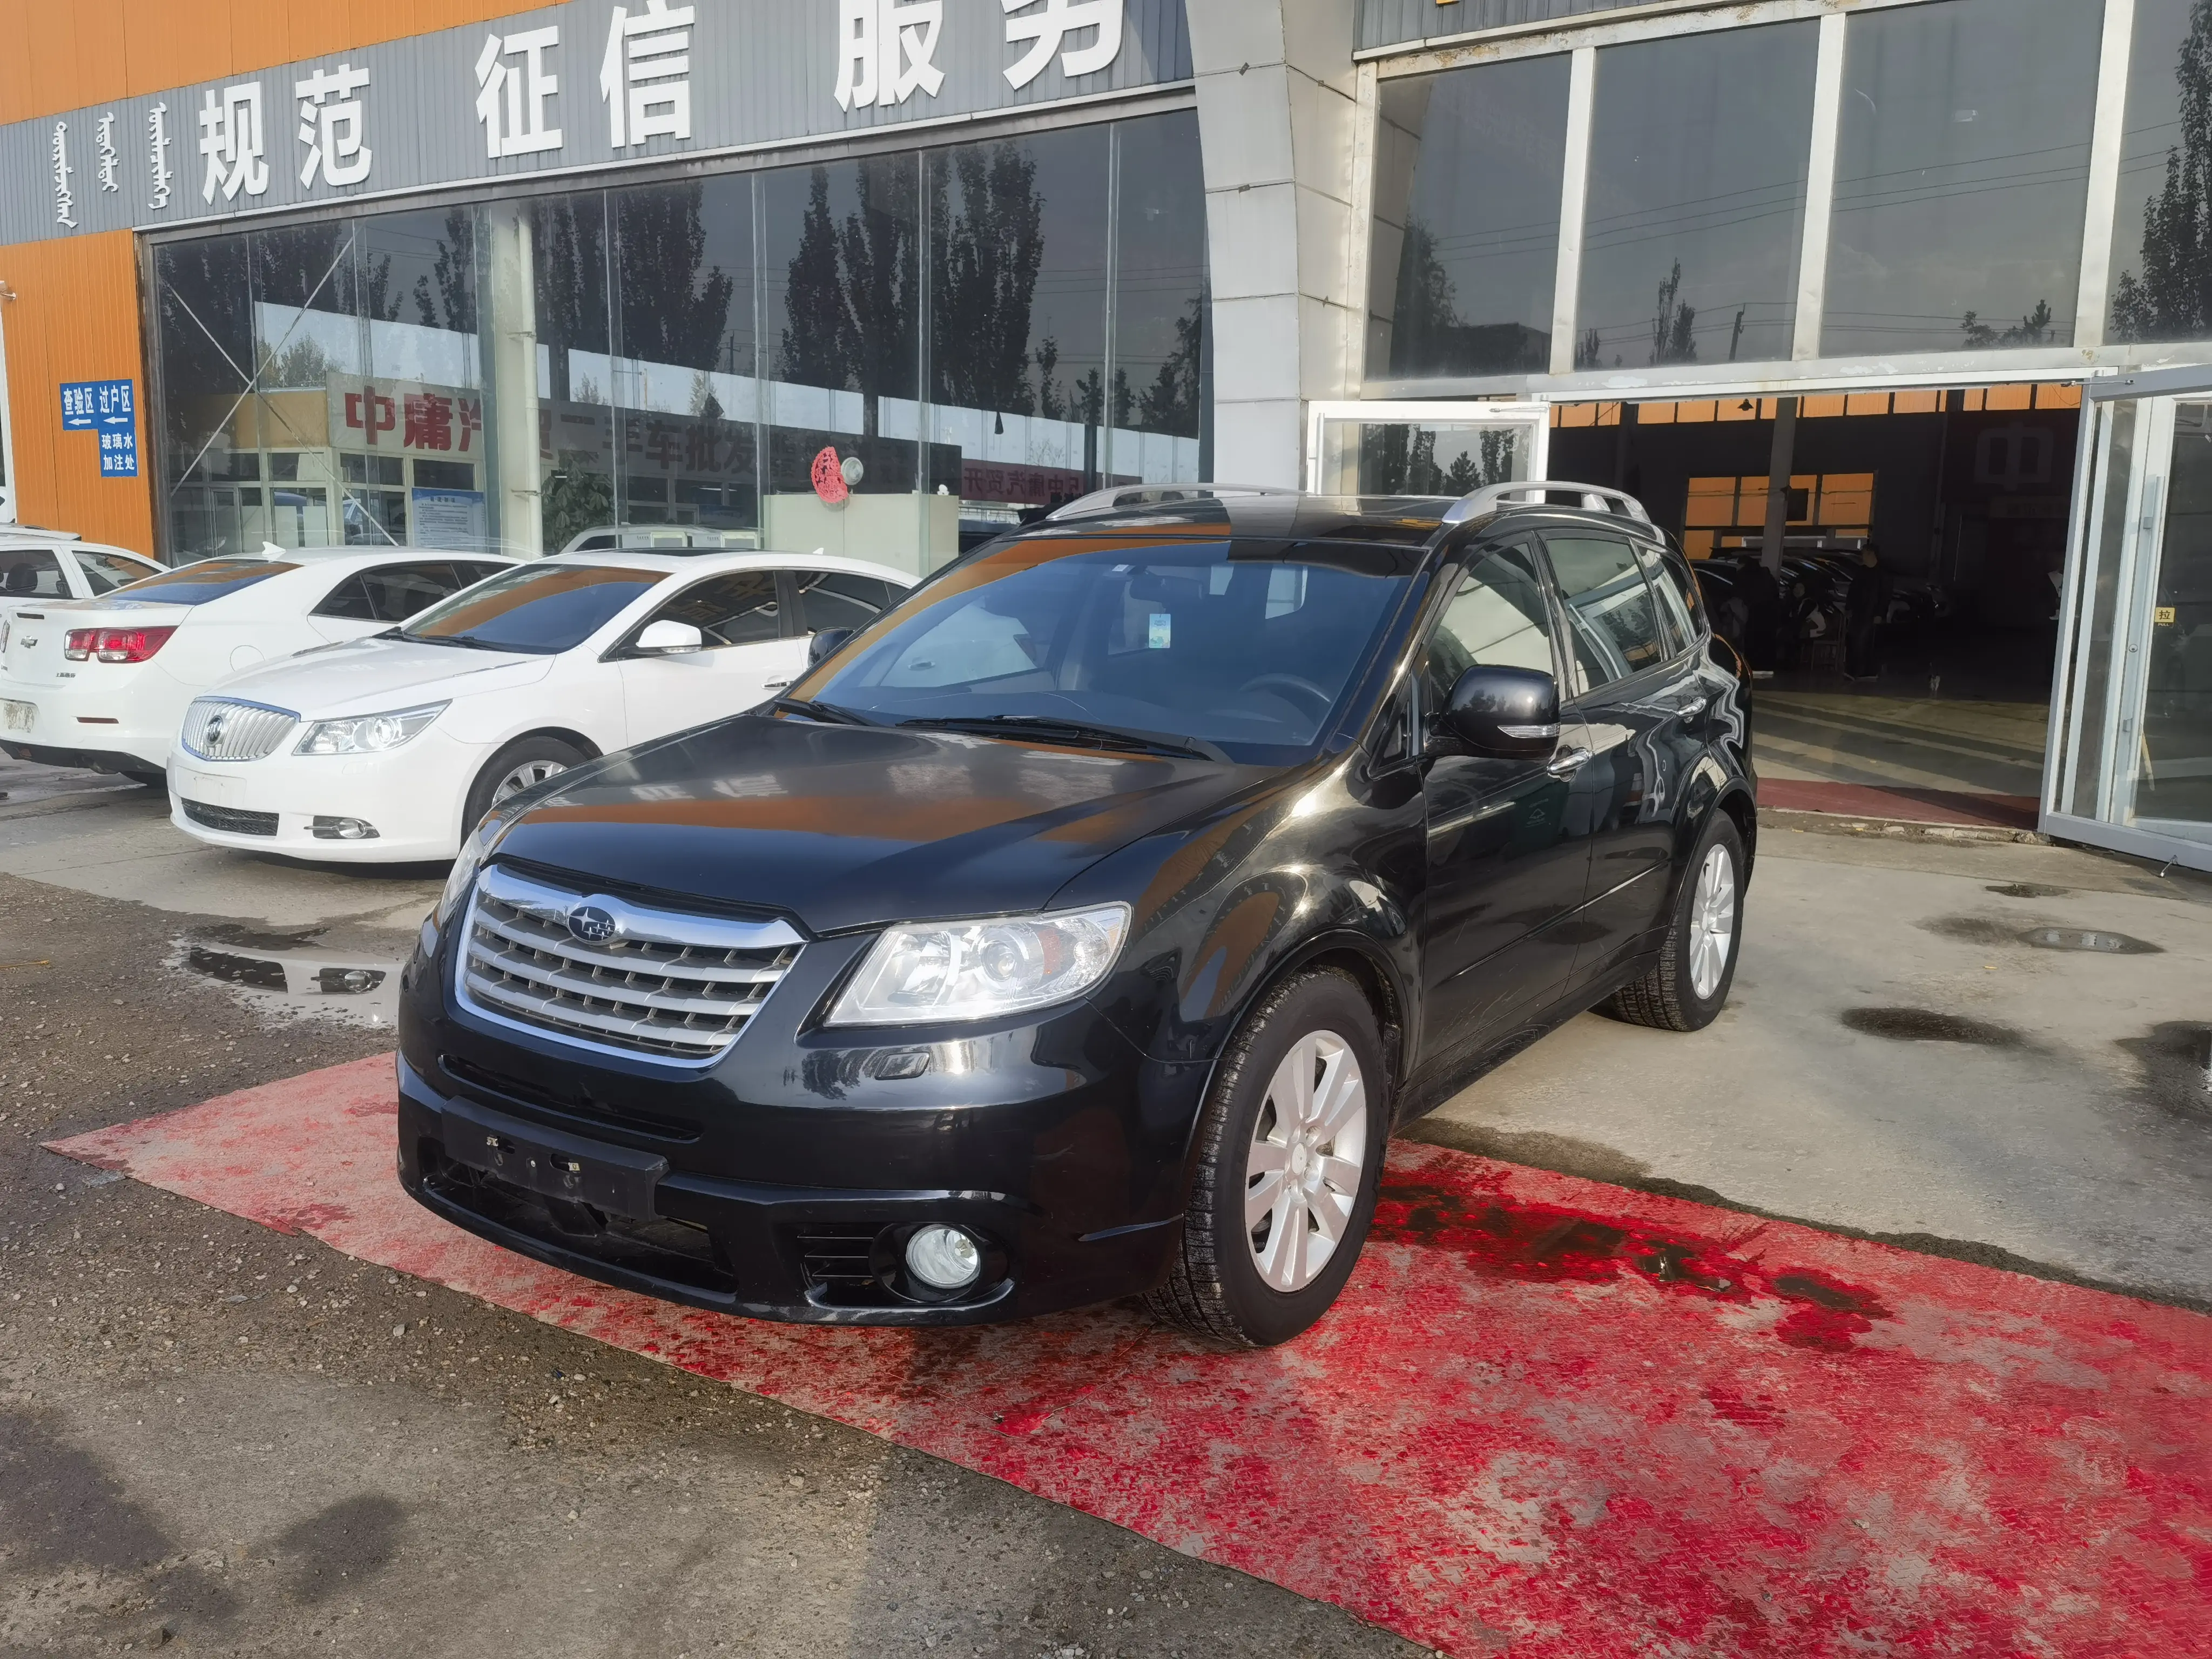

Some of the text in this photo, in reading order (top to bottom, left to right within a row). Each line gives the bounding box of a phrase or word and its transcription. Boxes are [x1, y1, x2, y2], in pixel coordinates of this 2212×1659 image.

[199, 63, 373, 206] 规范
[475, 0, 695, 159] 征信
[63, 387, 95, 415] 查验区
[99, 385, 131, 413] 过户区
[101, 433, 133, 449] 玻璃水
[103, 454, 135, 471] 加注处
[2159, 610, 2170, 619] 拉
